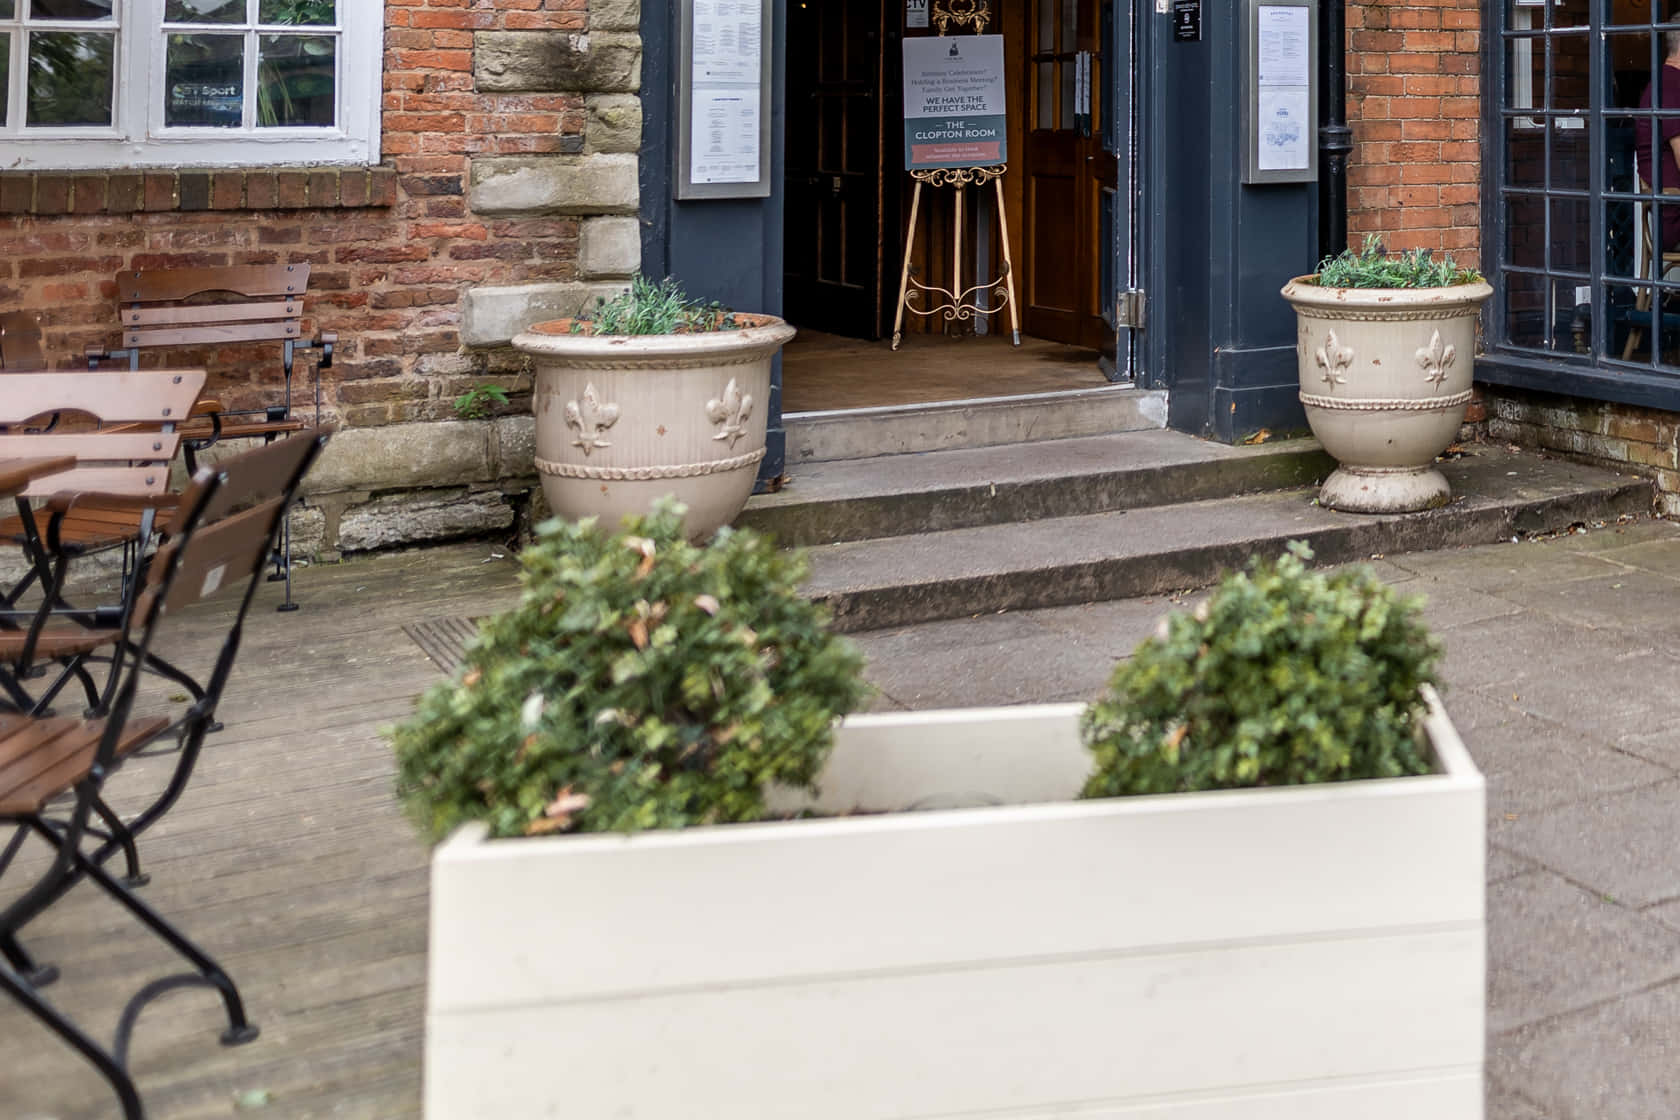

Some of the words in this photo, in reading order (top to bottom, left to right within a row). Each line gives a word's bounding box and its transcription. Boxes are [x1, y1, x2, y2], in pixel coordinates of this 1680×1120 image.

[202, 86, 236, 97] Sport
[926, 97, 941, 105] WE
[942, 96, 965, 104] HAVE
[968, 95, 984, 103] THE
[923, 104, 959, 113] PERFECT
[960, 103, 988, 112] SPACE
[946, 121, 965, 129] THE
[915, 130, 963, 140] CLOPTON
[965, 129, 996, 138] ROOM
